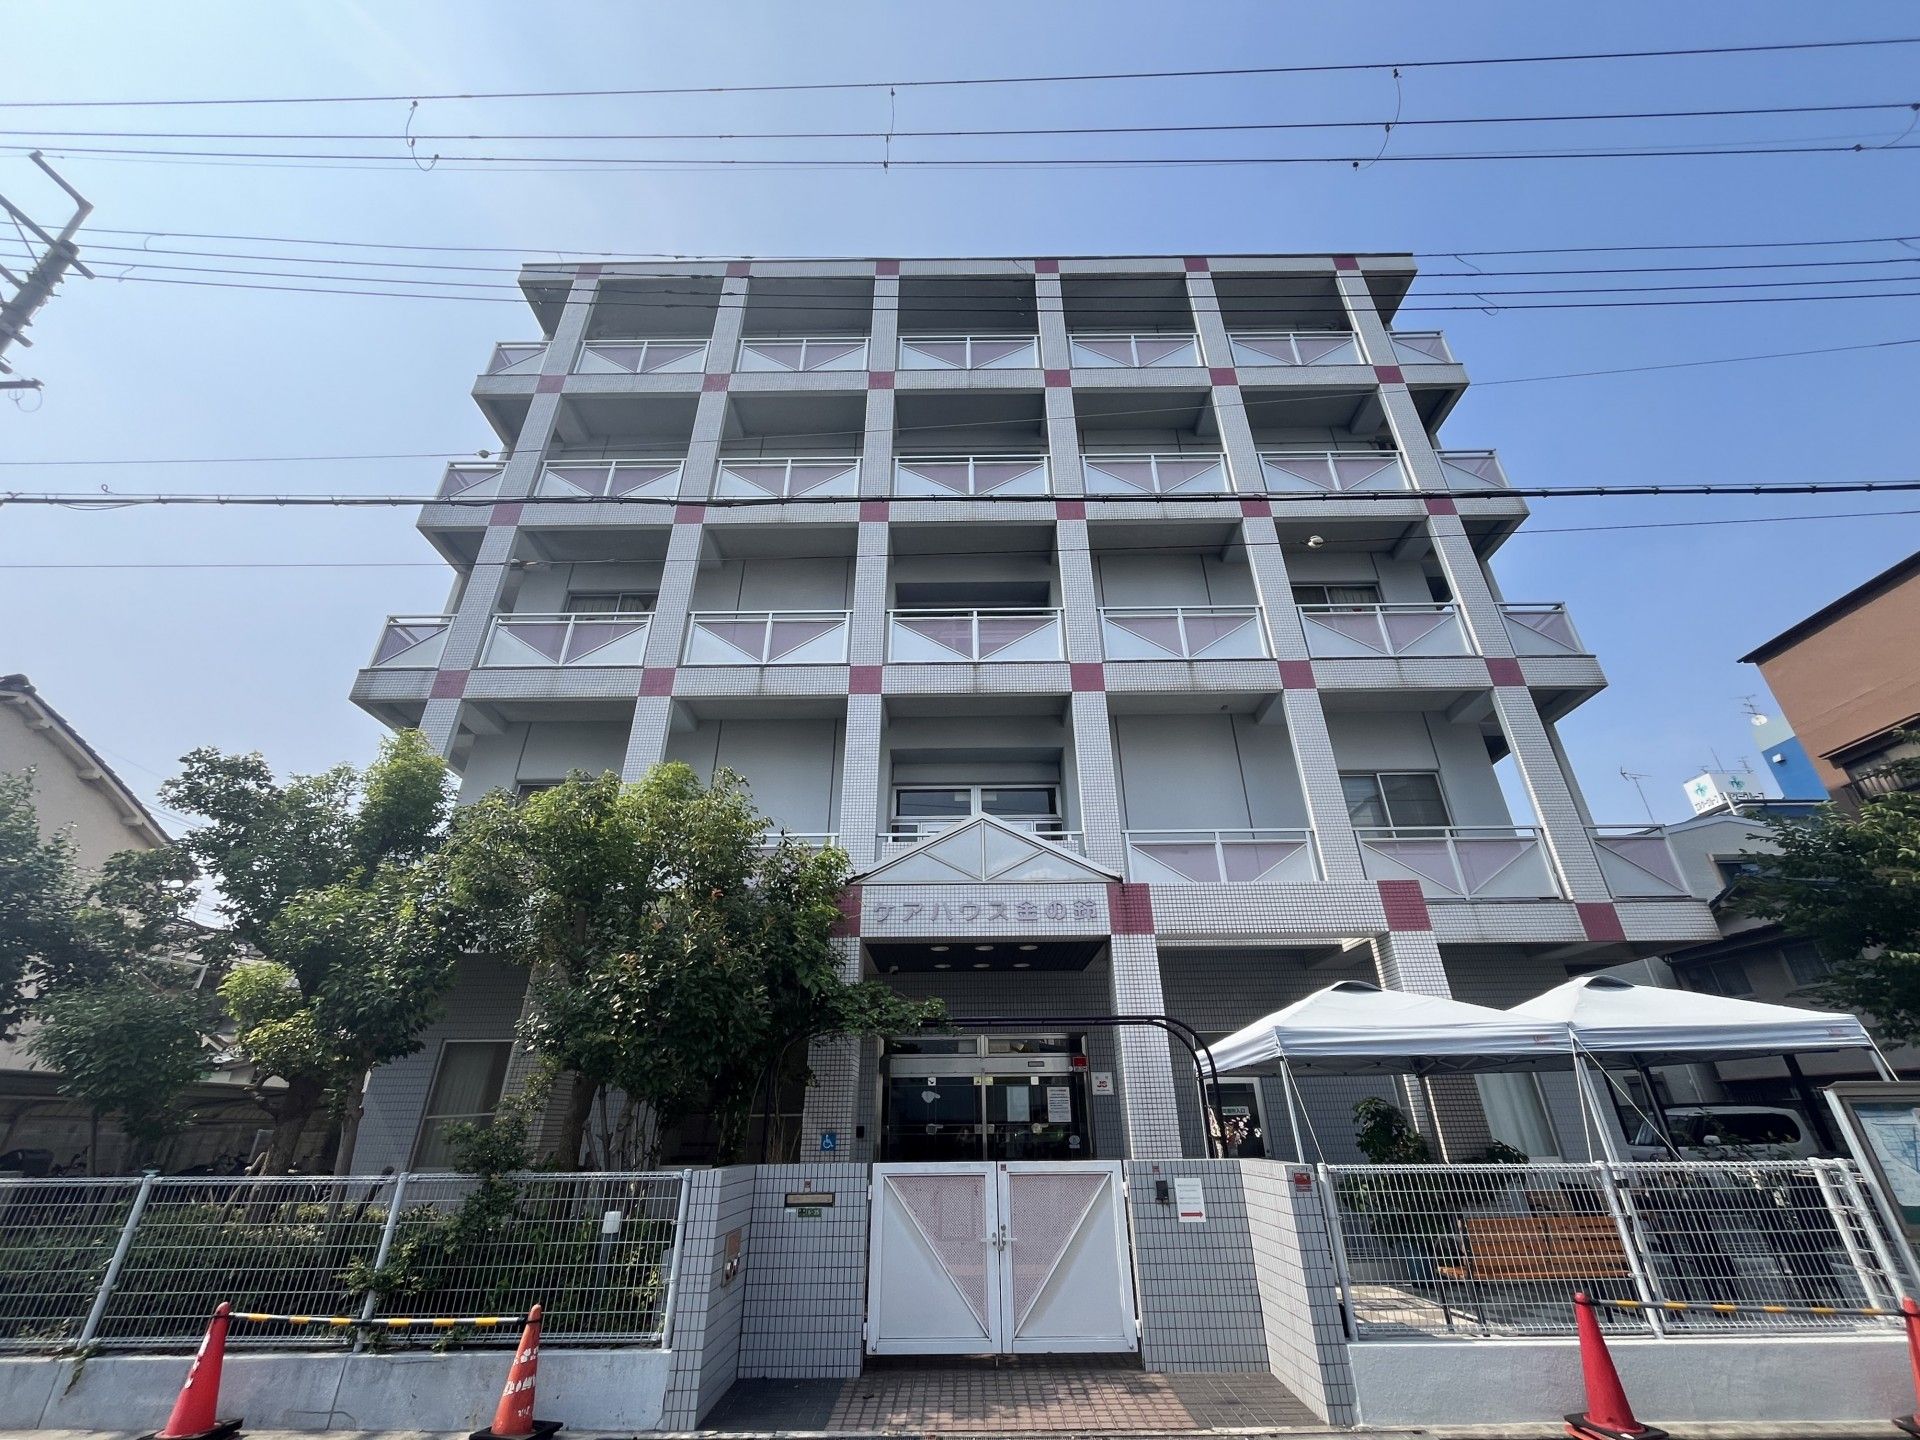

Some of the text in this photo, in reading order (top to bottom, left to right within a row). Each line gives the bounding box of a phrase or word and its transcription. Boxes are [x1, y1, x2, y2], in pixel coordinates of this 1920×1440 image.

[873, 900, 1099, 923] ケアハウス金の鈴
